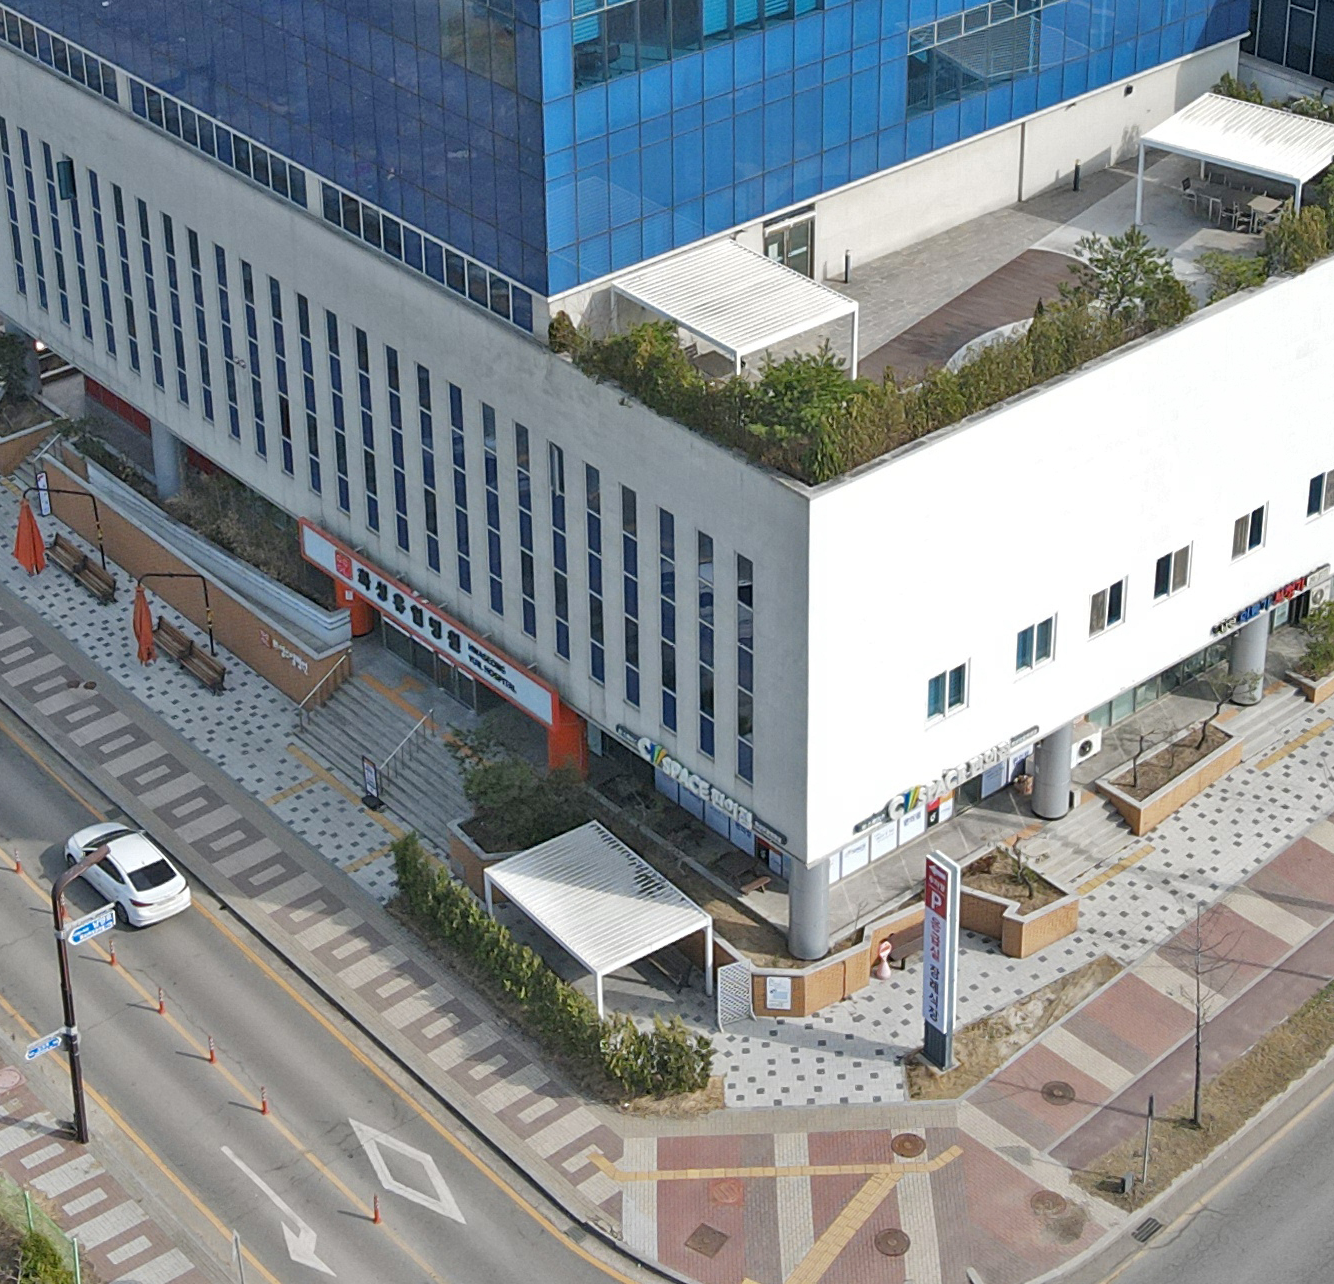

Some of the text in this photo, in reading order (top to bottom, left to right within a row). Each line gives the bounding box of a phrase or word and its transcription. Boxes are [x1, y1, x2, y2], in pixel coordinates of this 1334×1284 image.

[358, 568, 461, 653] 화성유일병원
[931, 892, 942, 910] P
[929, 916, 942, 1023] 응급실 장례식장
